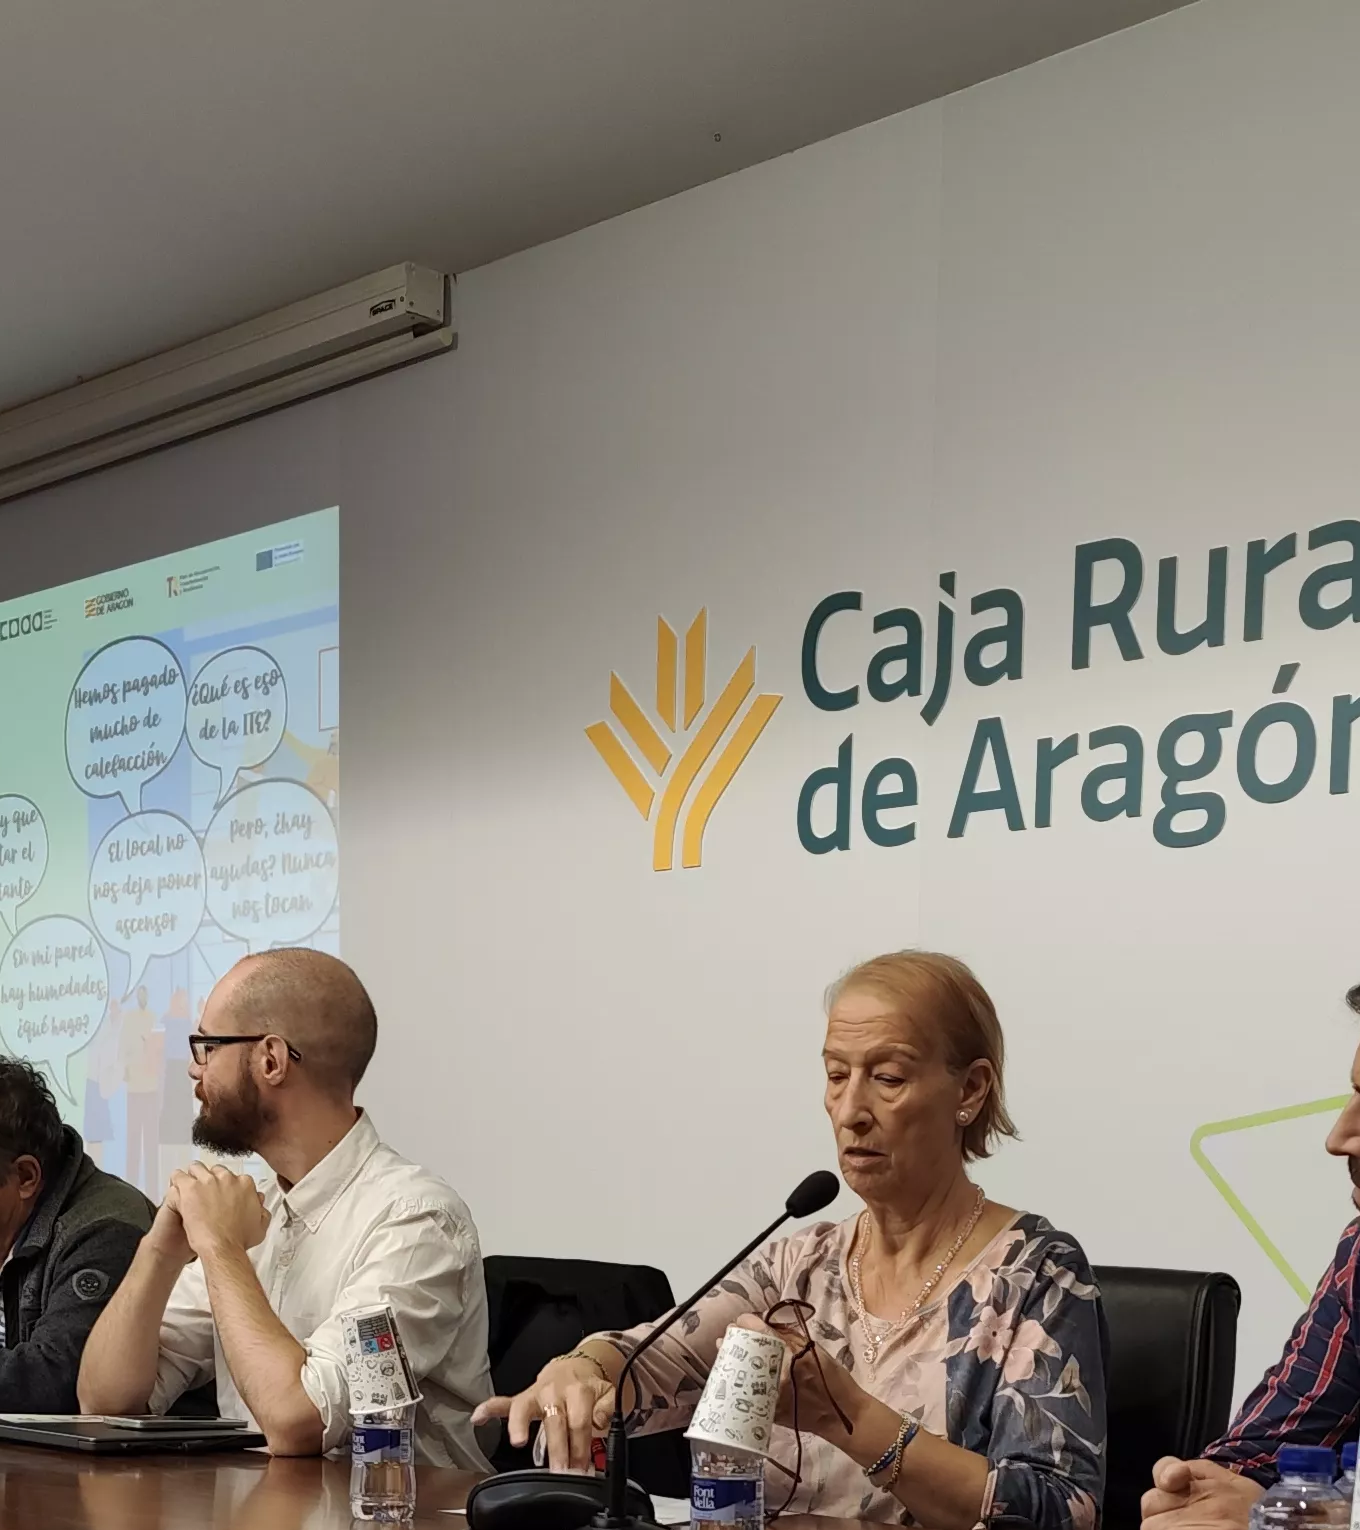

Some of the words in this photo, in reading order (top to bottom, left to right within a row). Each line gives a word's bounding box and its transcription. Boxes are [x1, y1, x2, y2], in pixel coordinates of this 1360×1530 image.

[96, 587, 130, 606] GOBIERNO
[800, 571, 1026, 726] Caja
[73, 682, 120, 709] Hemos
[122, 665, 179, 703] pagado
[191, 674, 231, 707] ¿Qué
[234, 676, 252, 700] es
[254, 668, 282, 696] eso
[90, 714, 140, 743] mucho
[143, 707, 162, 729] de
[199, 718, 219, 740] de
[221, 717, 239, 740] la
[242, 709, 272, 737] ITE?
[85, 742, 167, 780] calefacción
[796, 733, 919, 855] de
[12, 809, 38, 833] que
[21, 841, 35, 862] el
[126, 835, 164, 860] local
[166, 834, 187, 852] no
[93, 882, 121, 900] nos
[122, 874, 153, 905] deja
[157, 872, 201, 898] poner
[115, 912, 178, 940] ascensor
[54, 937, 95, 968] pared
[0, 983, 24, 1010] hay
[693, 1485, 715, 1498] Font
[693, 1496, 716, 1509] Vella
